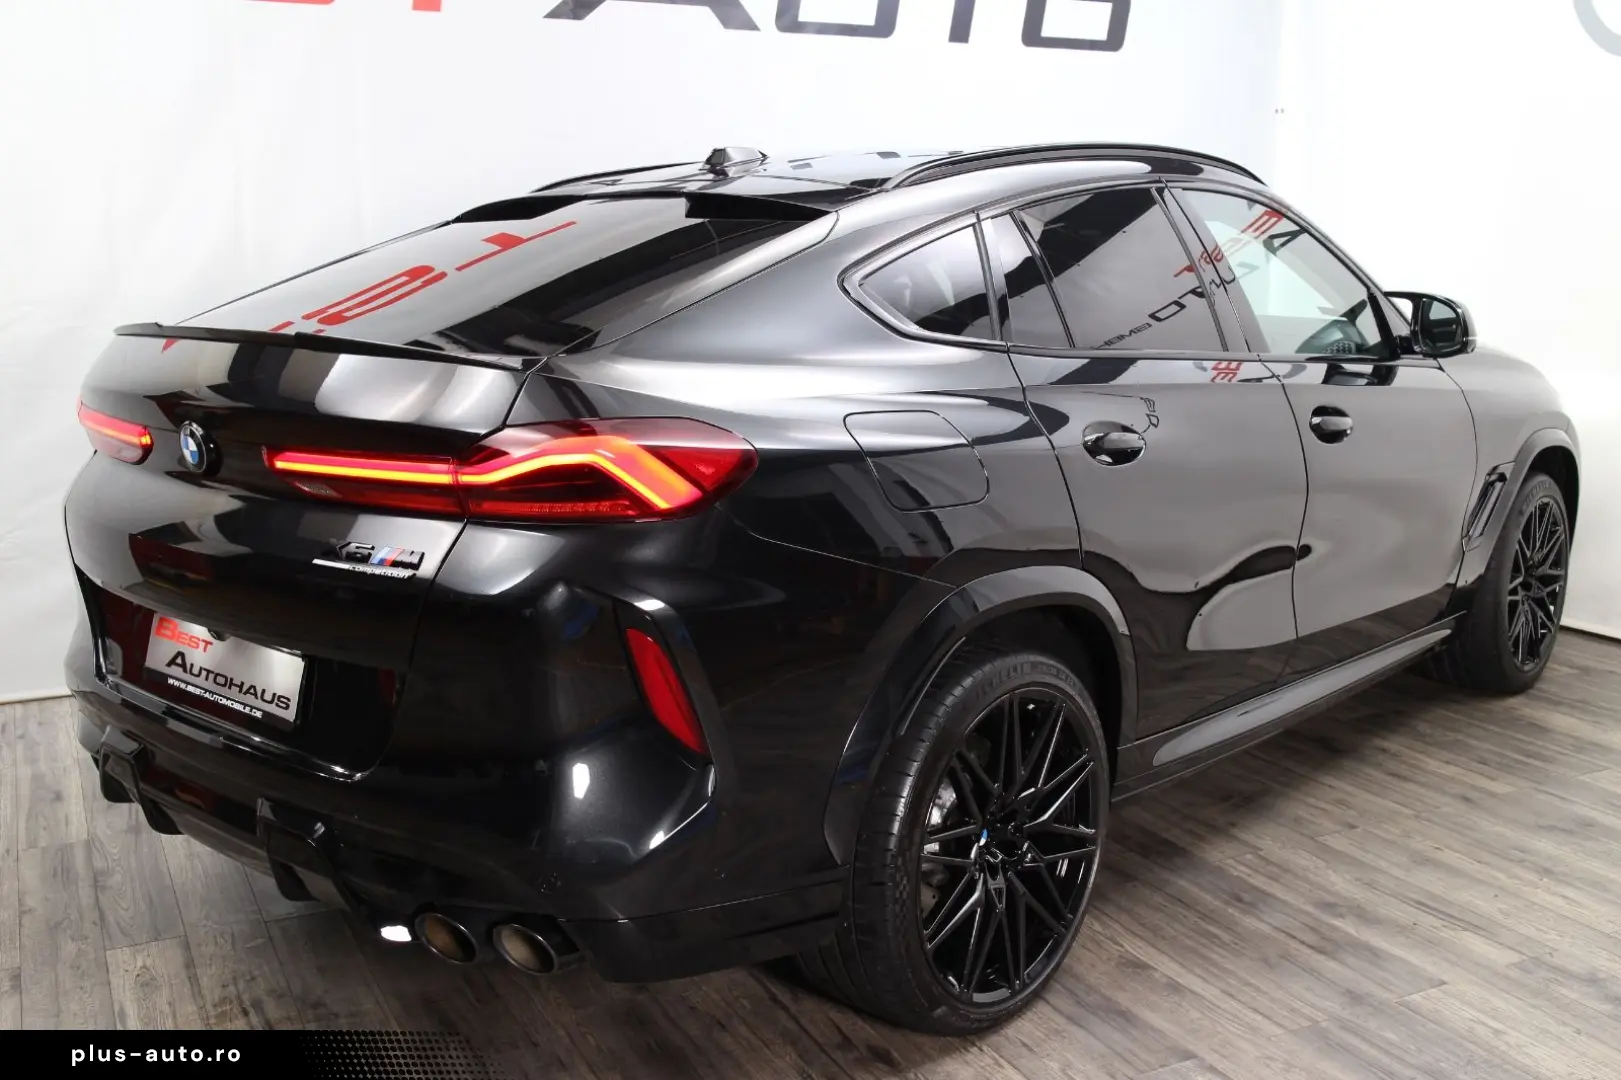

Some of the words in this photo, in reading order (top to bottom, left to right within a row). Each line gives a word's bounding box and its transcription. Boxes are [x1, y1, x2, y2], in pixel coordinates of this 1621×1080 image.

[349, 564, 417, 579] competition
[154, 616, 214, 653] BEST
[165, 650, 292, 711] AUTOHAUS
